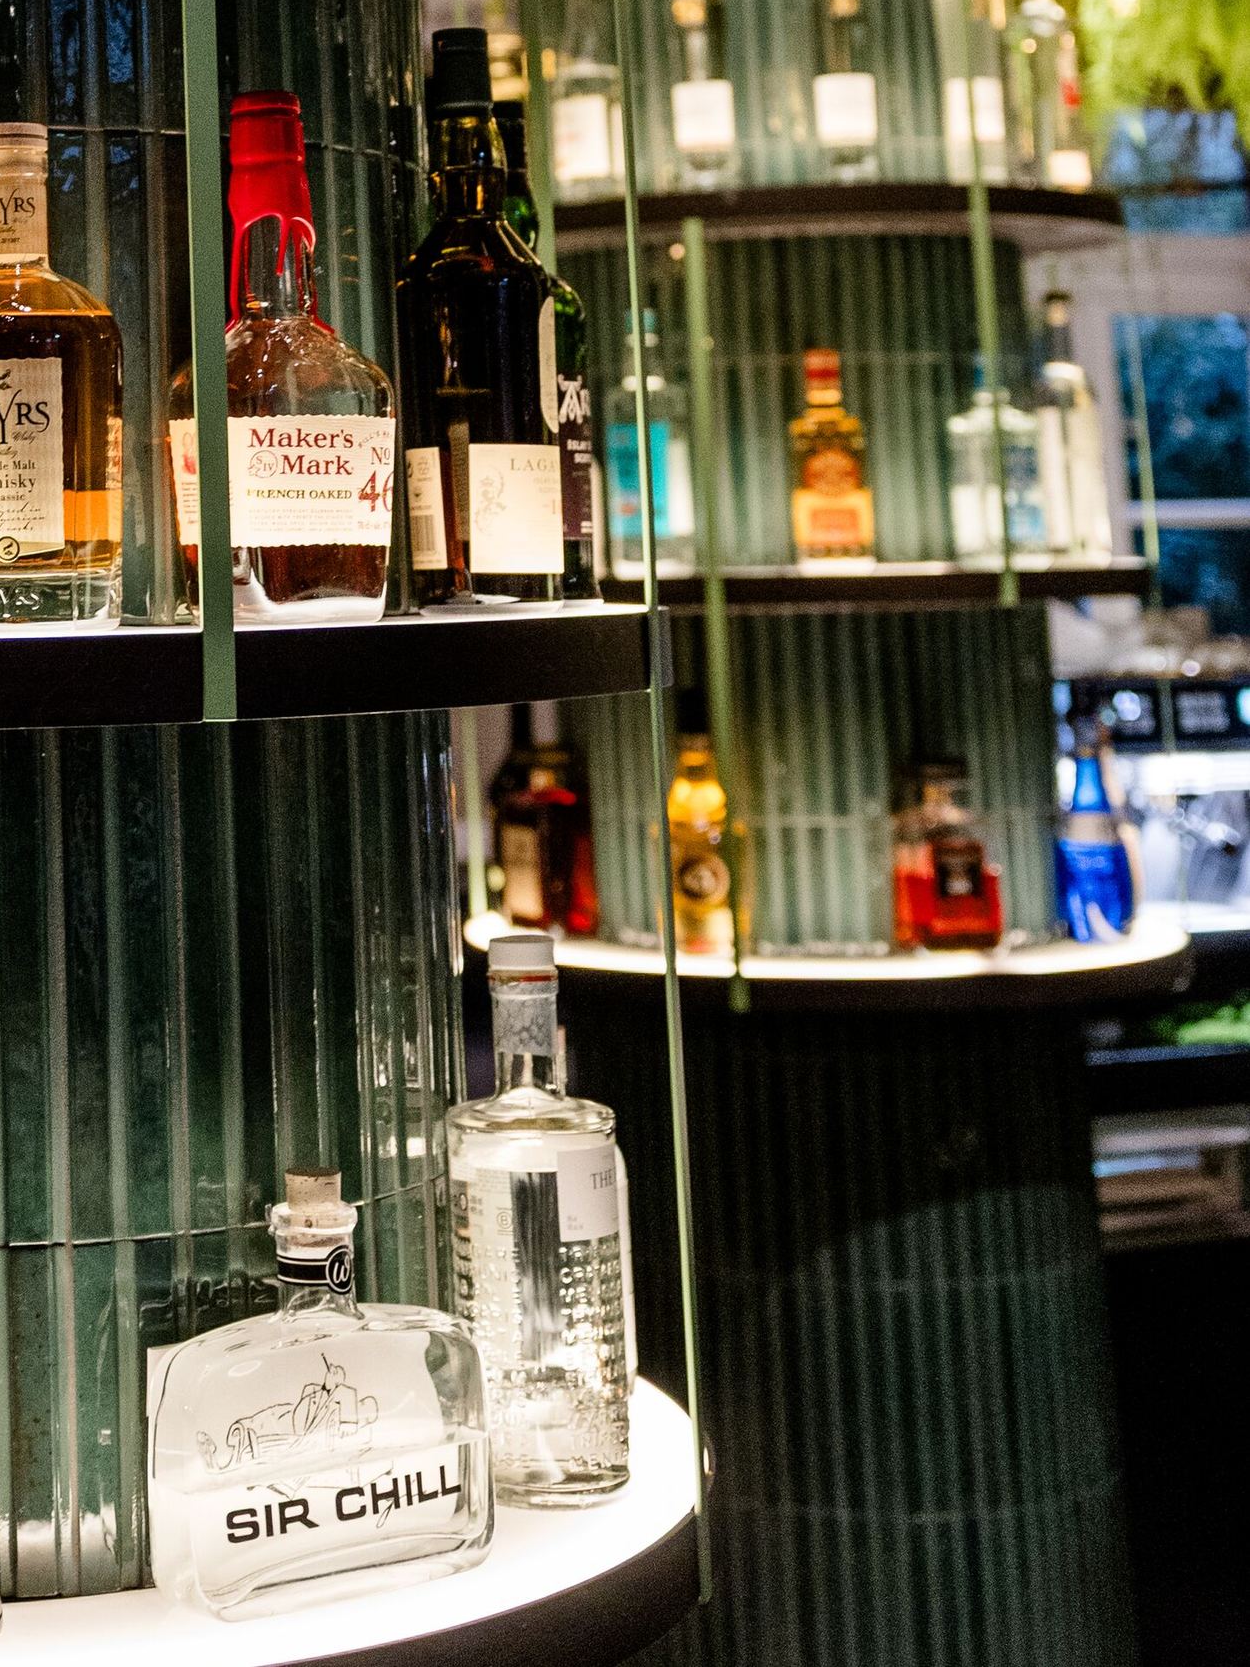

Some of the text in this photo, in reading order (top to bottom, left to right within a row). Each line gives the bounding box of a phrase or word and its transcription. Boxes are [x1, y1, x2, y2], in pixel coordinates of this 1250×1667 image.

[247, 428, 354, 449] Maker's
[12, 459, 36, 470] Malt
[280, 454, 352, 475] Mark
[248, 489, 352, 499] FRENCH OAKED
[590, 1167, 617, 1191] THE
[226, 1465, 462, 1545] SIR CHILL
